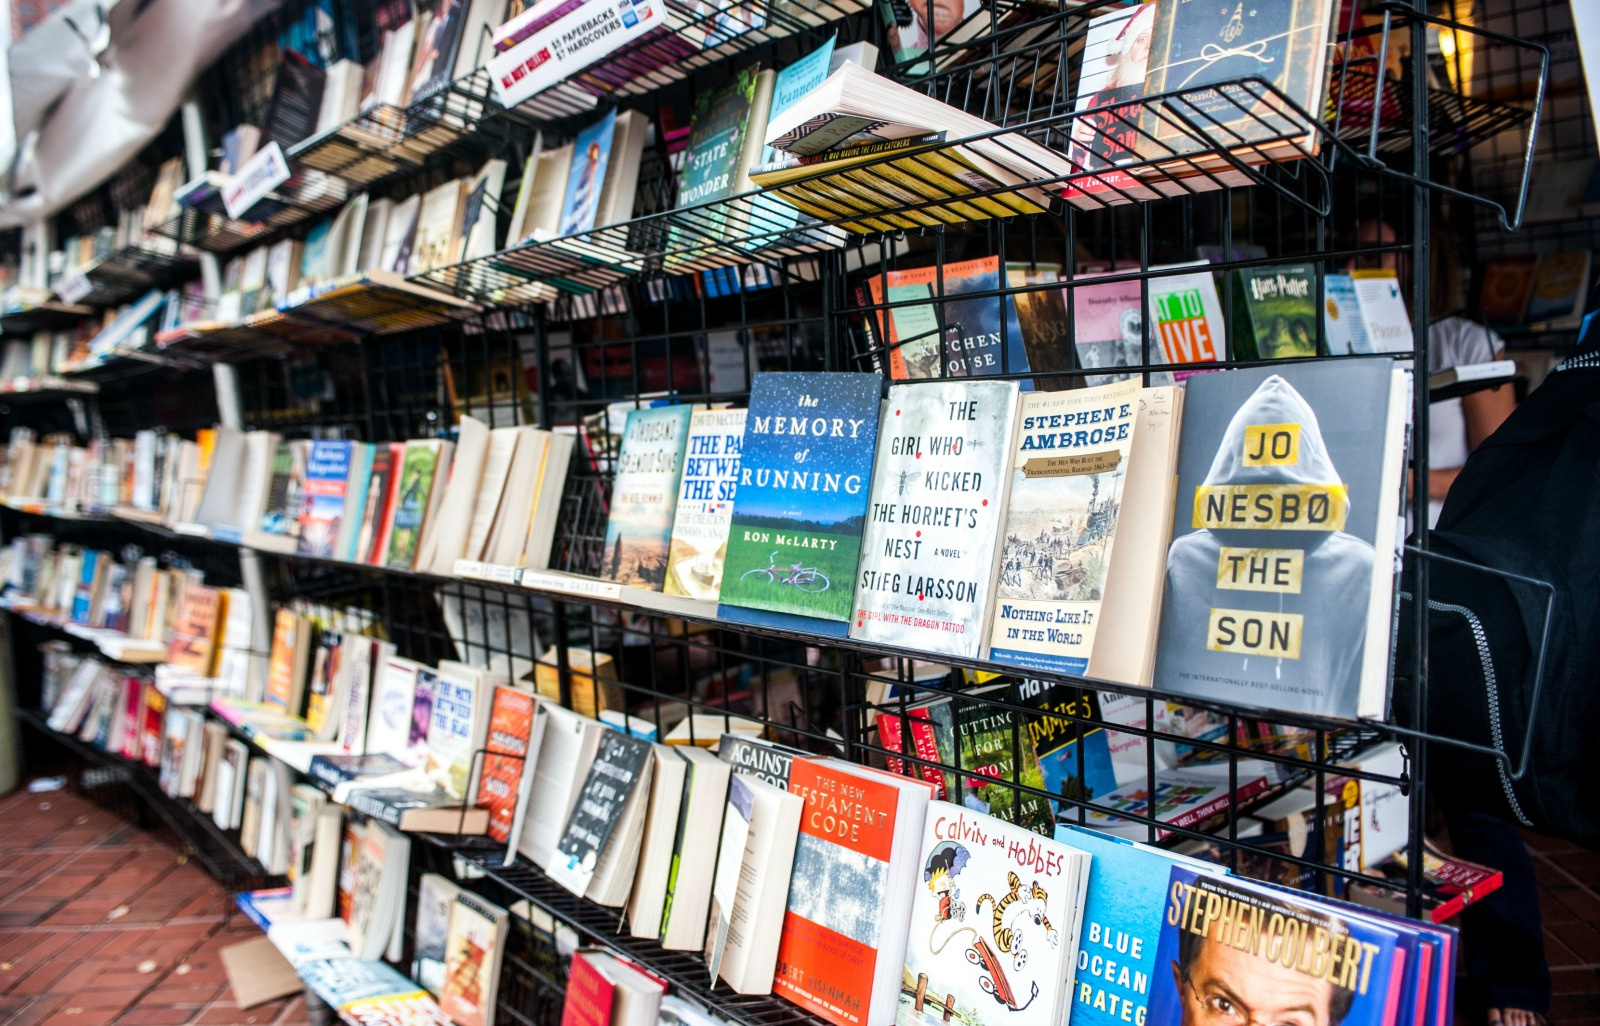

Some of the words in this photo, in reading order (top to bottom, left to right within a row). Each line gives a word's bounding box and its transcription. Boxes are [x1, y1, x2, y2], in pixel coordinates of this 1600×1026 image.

[563, 8, 615, 45] PAPERBACKS
[568, 18, 621, 58] HARDCOVERS
[775, 72, 824, 110] Jeannette
[1182, 89, 1219, 102] Randy
[693, 142, 729, 171] STATE
[799, 136, 831, 153] Alan
[860, 145, 870, 155] THE
[871, 144, 883, 153] FLAK
[680, 173, 729, 206] WONDER
[950, 260, 993, 273] BESTSELLER
[1251, 276, 1278, 301] Harry
[1275, 273, 1309, 298] Potter
[1088, 296, 1118, 306] Dorothy
[1179, 291, 1201, 317] TO
[920, 331, 1002, 358] KICHEN
[798, 394, 818, 407] the
[949, 401, 978, 421] THE
[1052, 400, 1065, 408] NEW
[1067, 398, 1082, 406] YORK
[752, 416, 865, 438] MEMORY
[1023, 407, 1115, 430] STEPHEN
[1118, 403, 1132, 419] E.
[691, 435, 722, 455] THE
[891, 436, 922, 456] GIRL
[930, 436, 964, 456] WHO
[1020, 422, 1130, 451] AMBROSE
[1249, 431, 1292, 460] JO
[794, 449, 810, 463] of
[683, 480, 715, 500] THE
[740, 468, 862, 494] RUNNING
[925, 471, 982, 493] KICKED
[873, 503, 897, 523] THE
[901, 505, 978, 529] HORNET'S
[1206, 493, 1330, 524] NESBØ
[743, 531, 770, 543] RON
[775, 534, 838, 551] McLARTY
[885, 537, 922, 560] NEST
[934, 548, 939, 557] A
[940, 548, 961, 559] NOVEL
[1227, 556, 1292, 586] THE
[861, 570, 901, 593] STIEG
[906, 575, 978, 603] LARSSON
[857, 609, 867, 619] THE
[867, 610, 882, 621] GIRL
[883, 612, 899, 624] WITH
[900, 615, 912, 626] THE
[913, 617, 940, 630] DRAGON
[941, 621, 965, 634] TATTOO
[1001, 604, 1053, 623] NOTHING
[1055, 608, 1081, 625] LIKE
[1082, 610, 1094, 625] IT
[1007, 627, 1019, 640] IN
[1022, 629, 1044, 642] THE
[1047, 628, 1083, 645] WORLD
[1216, 616, 1290, 651] SON
[1179, 672, 1191, 680] THE
[1192, 674, 1249, 688] INTERNATIONALLY
[1250, 681, 1300, 694] BEST-SELLING
[1301, 688, 1324, 697] NOVEL
[730, 742, 793, 778] AGAINST
[917, 739, 931, 777] STOE
[975, 739, 1003, 757] FOR
[816, 776, 836, 793] THE
[840, 784, 865, 800] NEW
[792, 784, 888, 830] TESTAMENT
[1180, 813, 1198, 828] WELL,
[1196, 806, 1214, 819] THINK
[810, 811, 859, 843] CODE
[992, 836, 1005, 849] and
[1201, 882, 1216, 892] FROM
[1217, 886, 1227, 895] THE
[1228, 890, 1250, 902] AUTHOR
[1271, 904, 1296, 917] AMERICA
[1311, 916, 1319, 924] SO
[1320, 919, 1333, 929] CAN
[1089, 921, 1144, 960] BLUE
[1167, 880, 1266, 956] STEPHEN
[1265, 911, 1380, 996] COLBERT
[1077, 949, 1148, 995] OCEAN
[776, 960, 804, 983] OBERT
[808, 975, 860, 1012] EISENMAN
[1074, 979, 1148, 1026] RATEG
